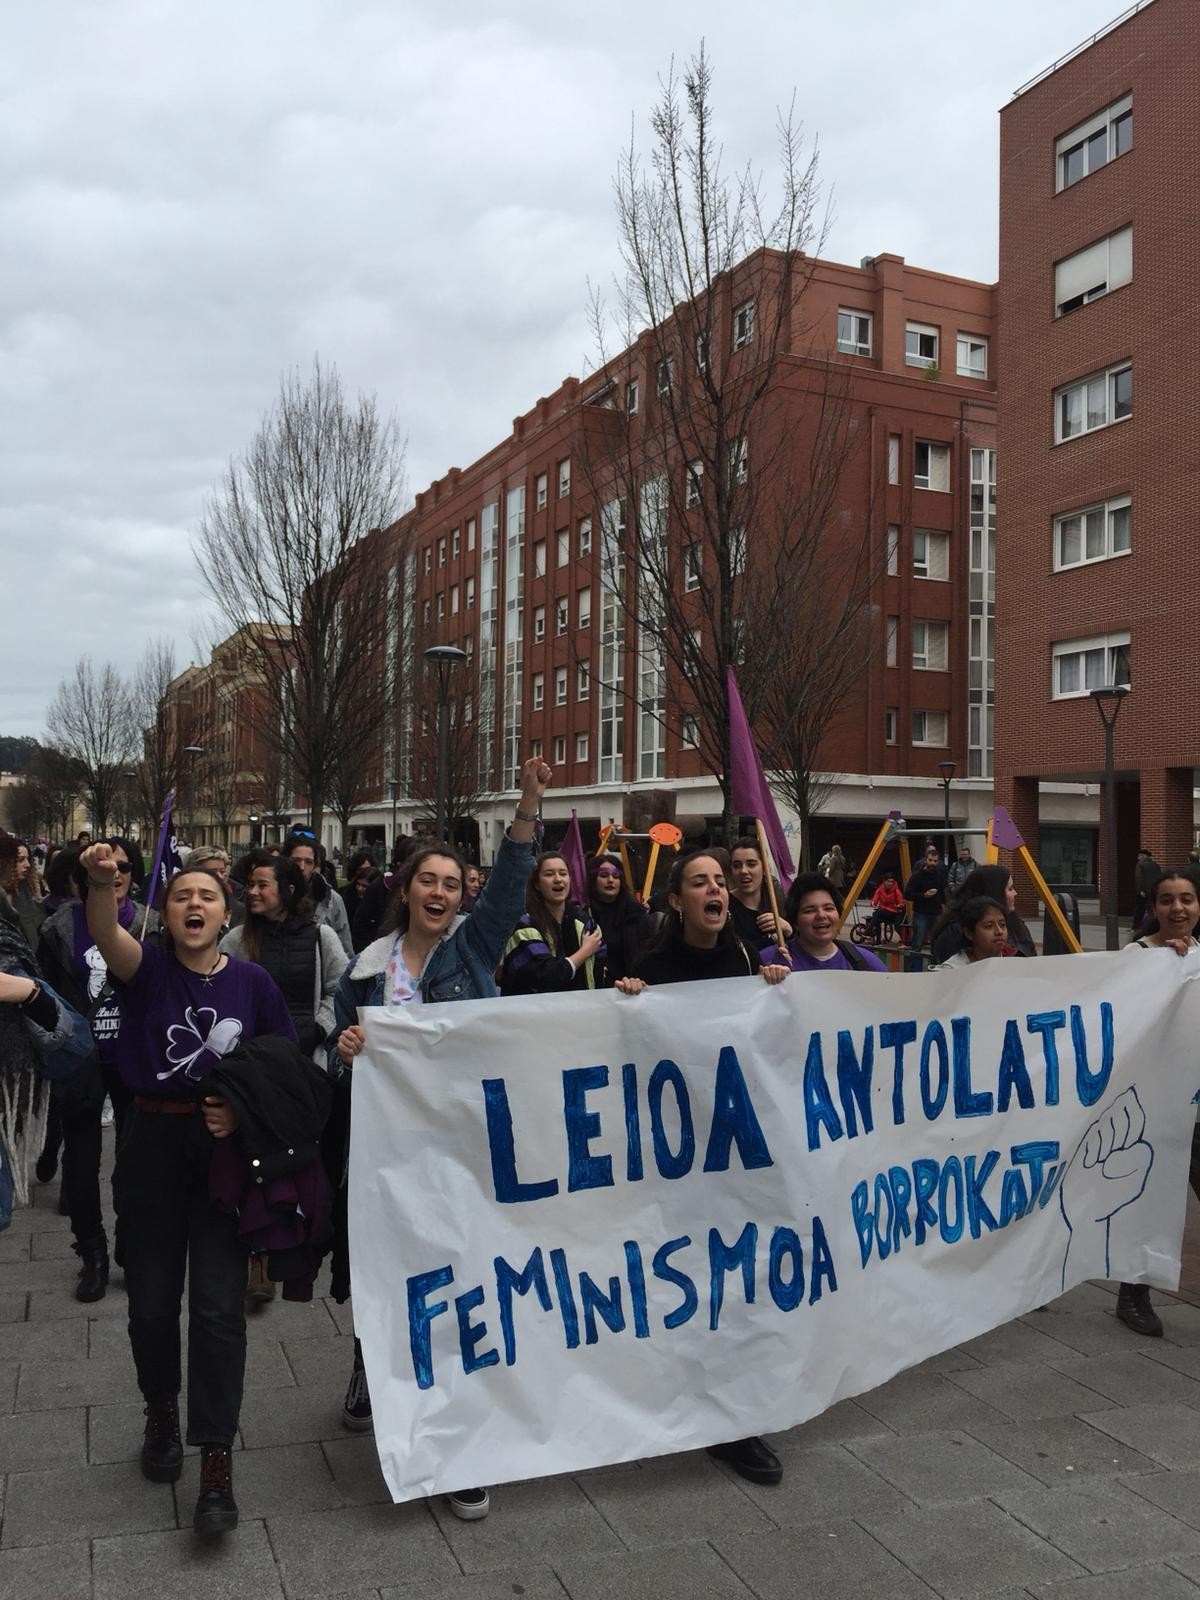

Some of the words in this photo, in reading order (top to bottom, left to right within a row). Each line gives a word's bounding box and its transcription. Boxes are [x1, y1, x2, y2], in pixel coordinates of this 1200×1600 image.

[482, 1046, 774, 1203] LEIOA
[803, 1002, 1114, 1152] ANTOLATU
[406, 1216, 839, 1389] FEMINISMOA
[850, 1141, 1067, 1270] BORROKATU
